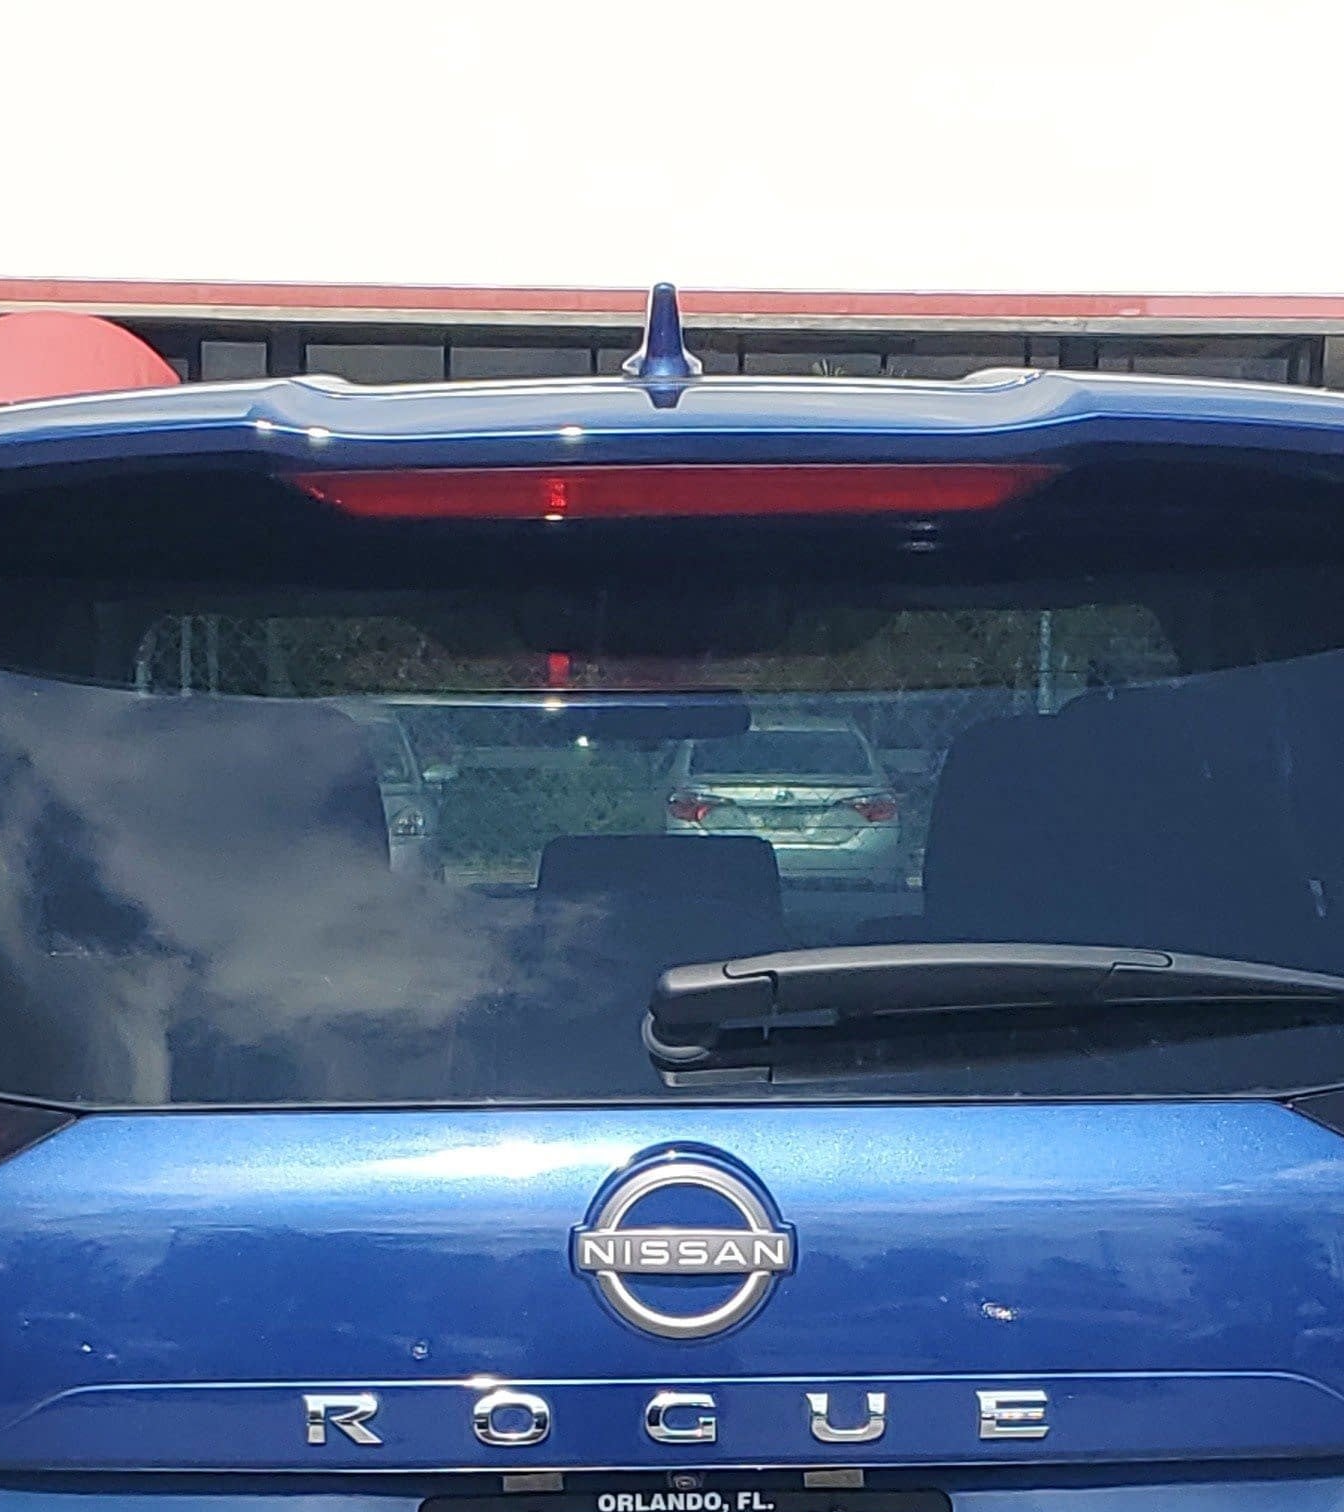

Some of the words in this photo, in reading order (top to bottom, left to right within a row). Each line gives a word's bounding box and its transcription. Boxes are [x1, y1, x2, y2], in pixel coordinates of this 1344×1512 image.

[582, 1239, 785, 1266] NISSAN
[302, 1388, 1051, 1446] ROGUE
[737, 1491, 774, 1511] FL.
